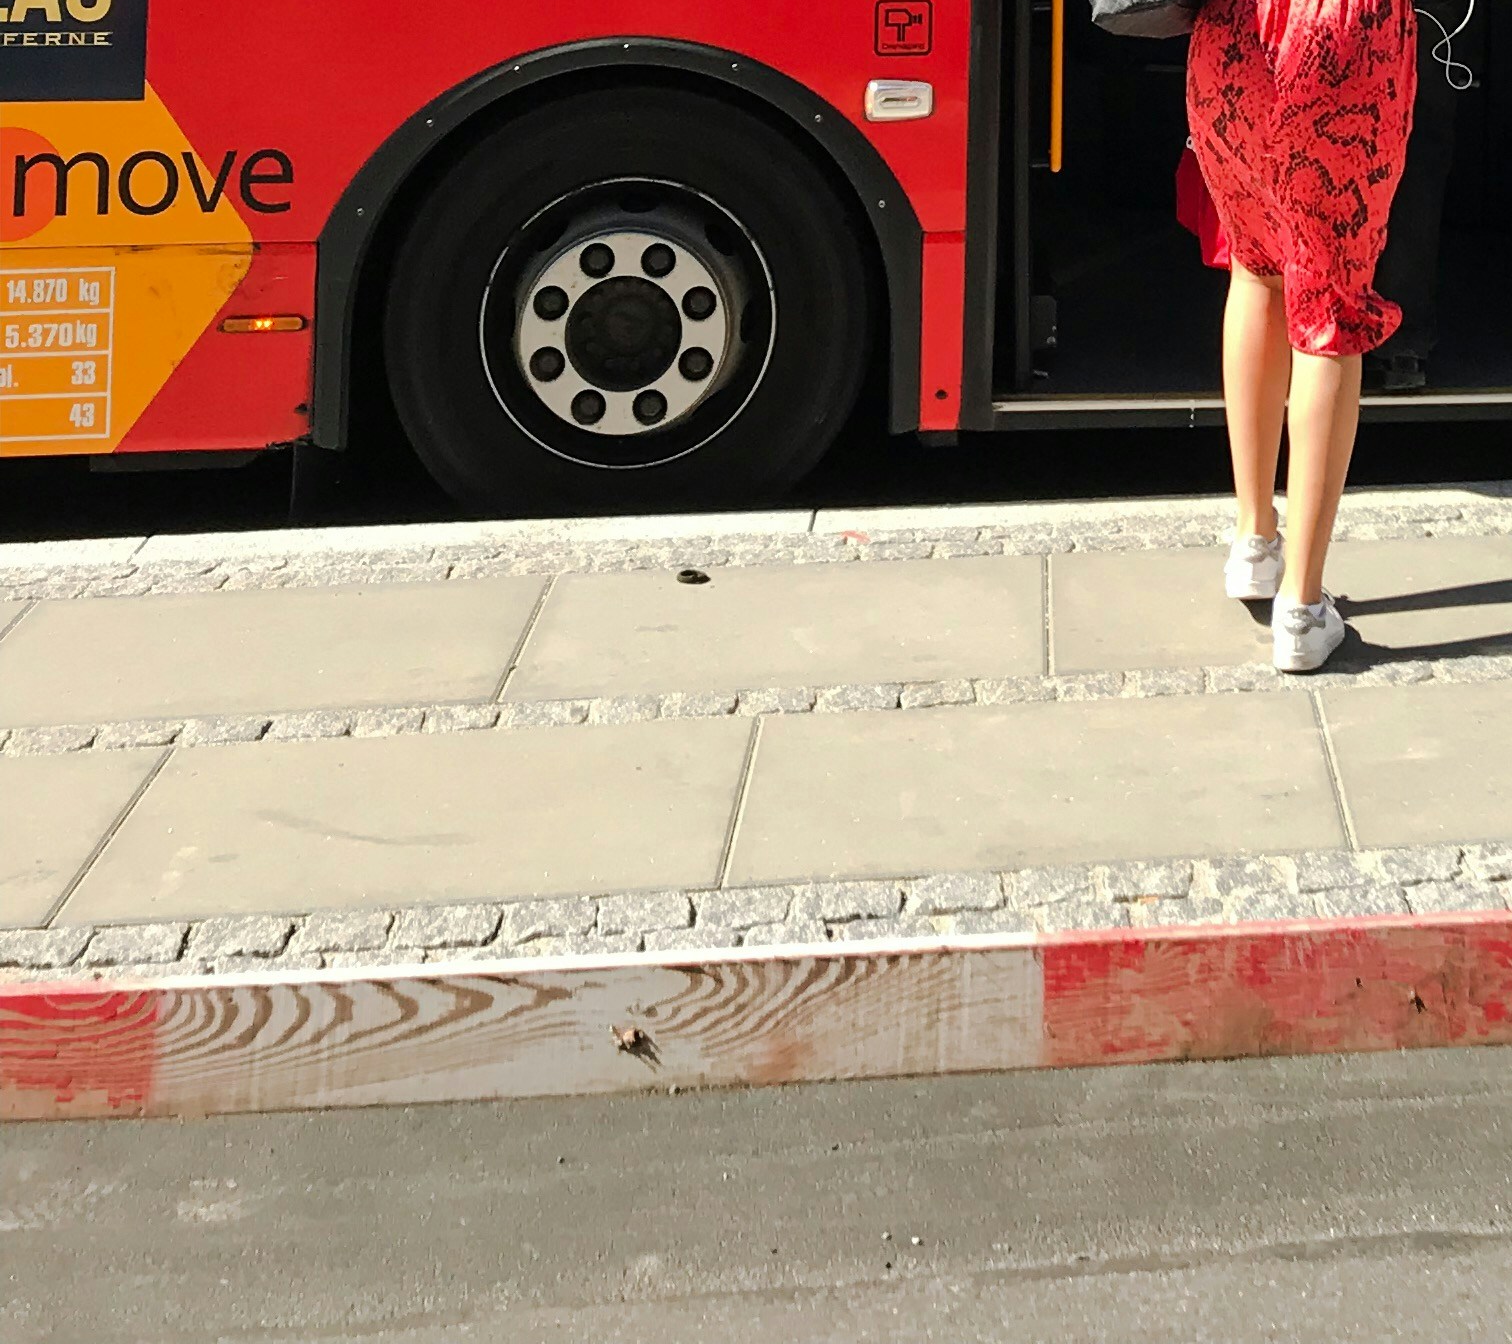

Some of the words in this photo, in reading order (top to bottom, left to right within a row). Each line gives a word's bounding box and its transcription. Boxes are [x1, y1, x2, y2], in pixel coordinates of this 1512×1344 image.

[3, 32, 110, 46] FERNE
[13, 149, 293, 216] move
[7, 278, 67, 303] 14.870
[79, 278, 99, 305] kg
[5, 322, 73, 348] 5.370
[75, 320, 97, 348] kg
[71, 361, 96, 385] 33
[69, 403, 95, 427] 43
